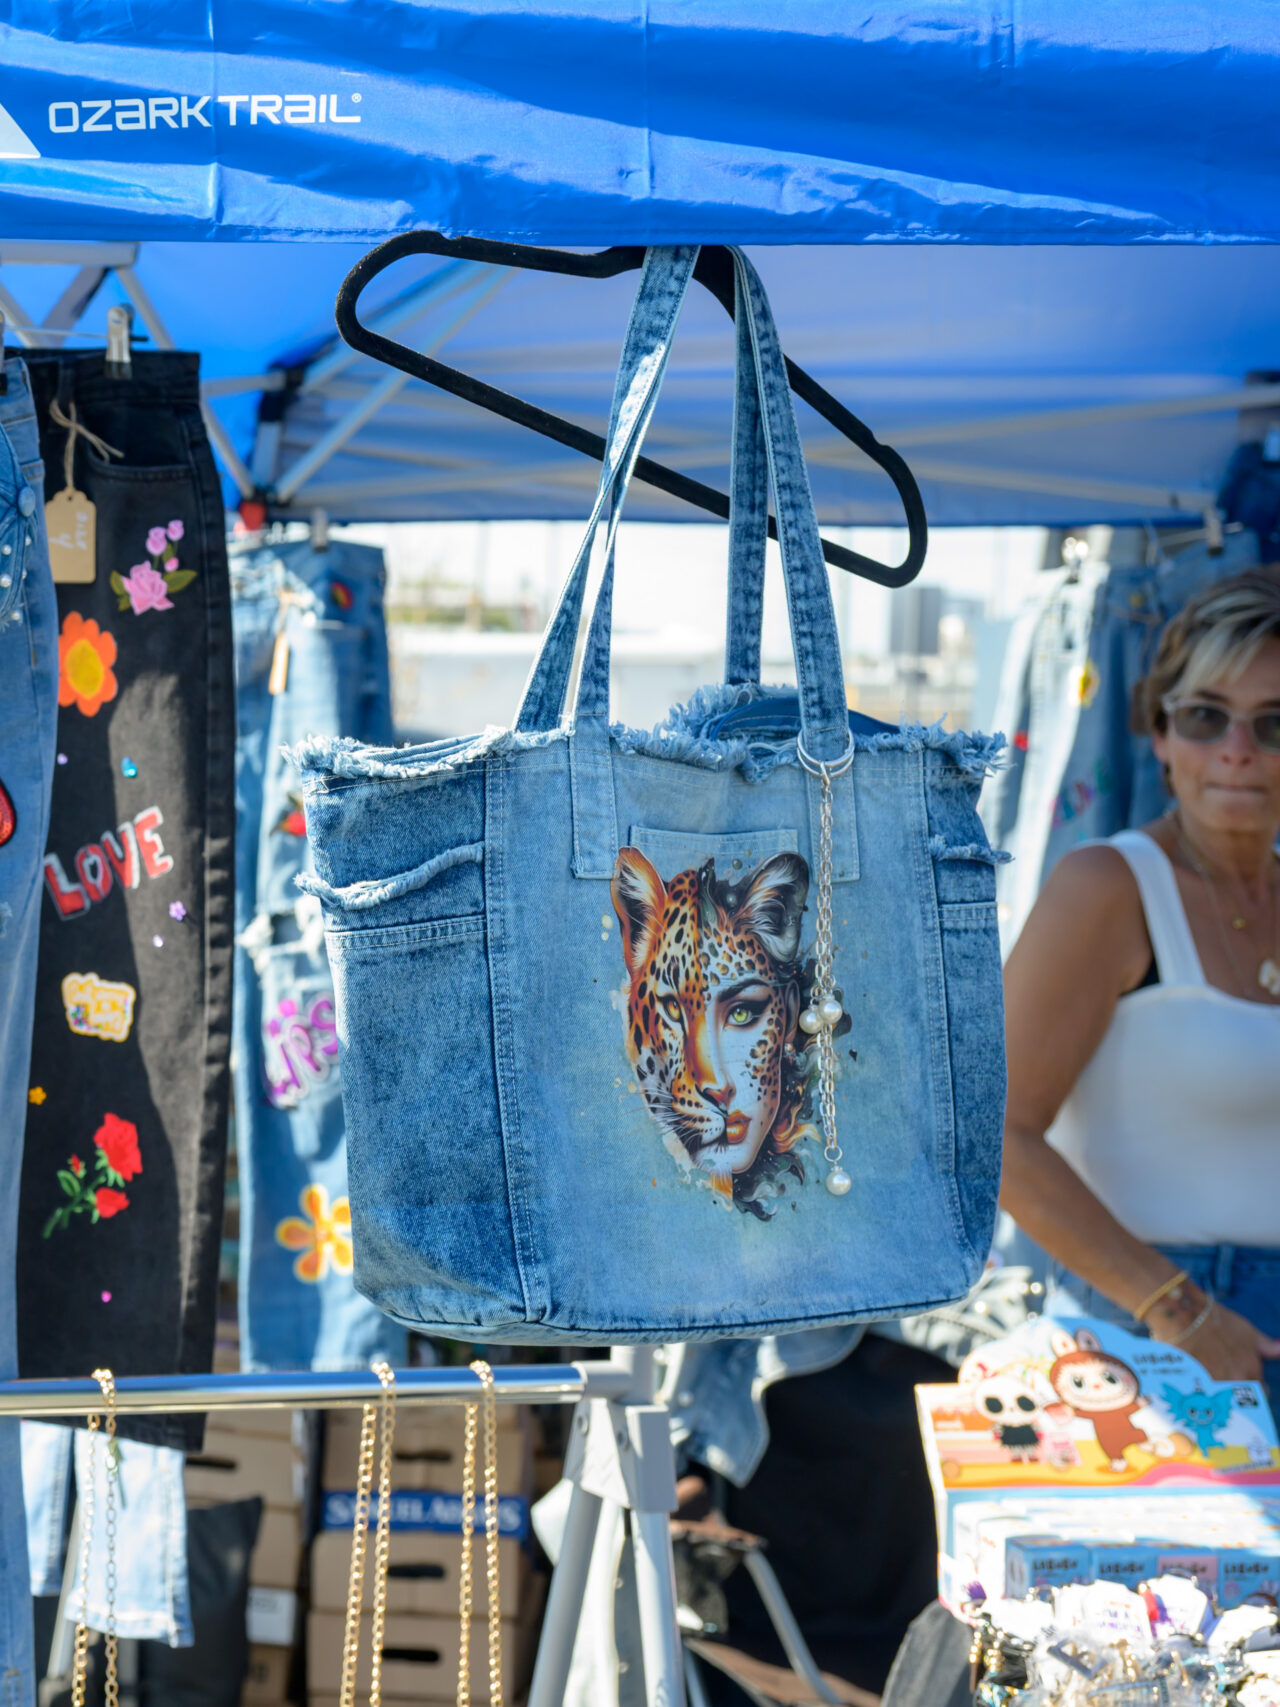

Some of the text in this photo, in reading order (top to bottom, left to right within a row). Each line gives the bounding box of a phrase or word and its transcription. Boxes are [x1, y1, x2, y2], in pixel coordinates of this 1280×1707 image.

[48, 96, 213, 134] OZARK
[43, 806, 173, 921] LOVE
[325, 1494, 520, 1532] SUEL ADS
